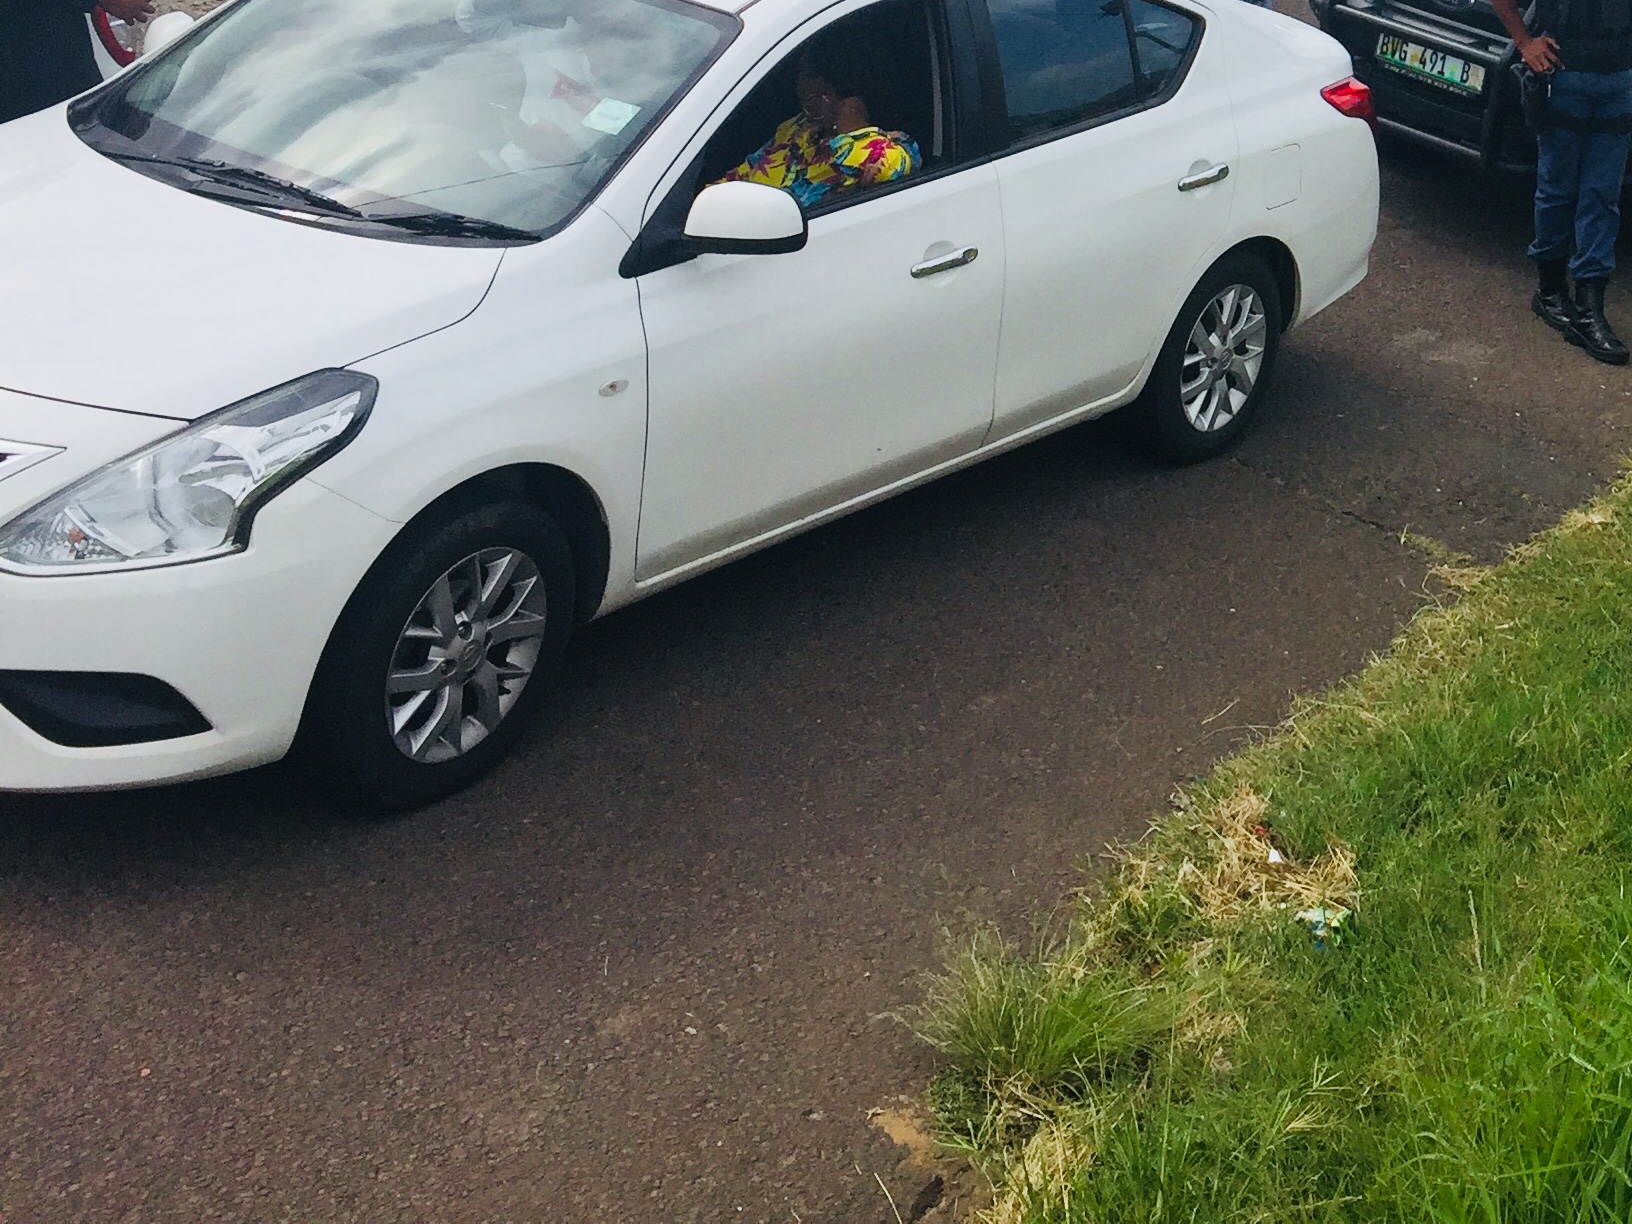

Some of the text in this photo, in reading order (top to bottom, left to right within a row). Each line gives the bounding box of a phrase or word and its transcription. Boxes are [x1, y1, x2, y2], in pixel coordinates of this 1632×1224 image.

[1379, 34, 1409, 63] BVG
[1418, 46, 1448, 78] 491
[1460, 60, 1472, 84] B
